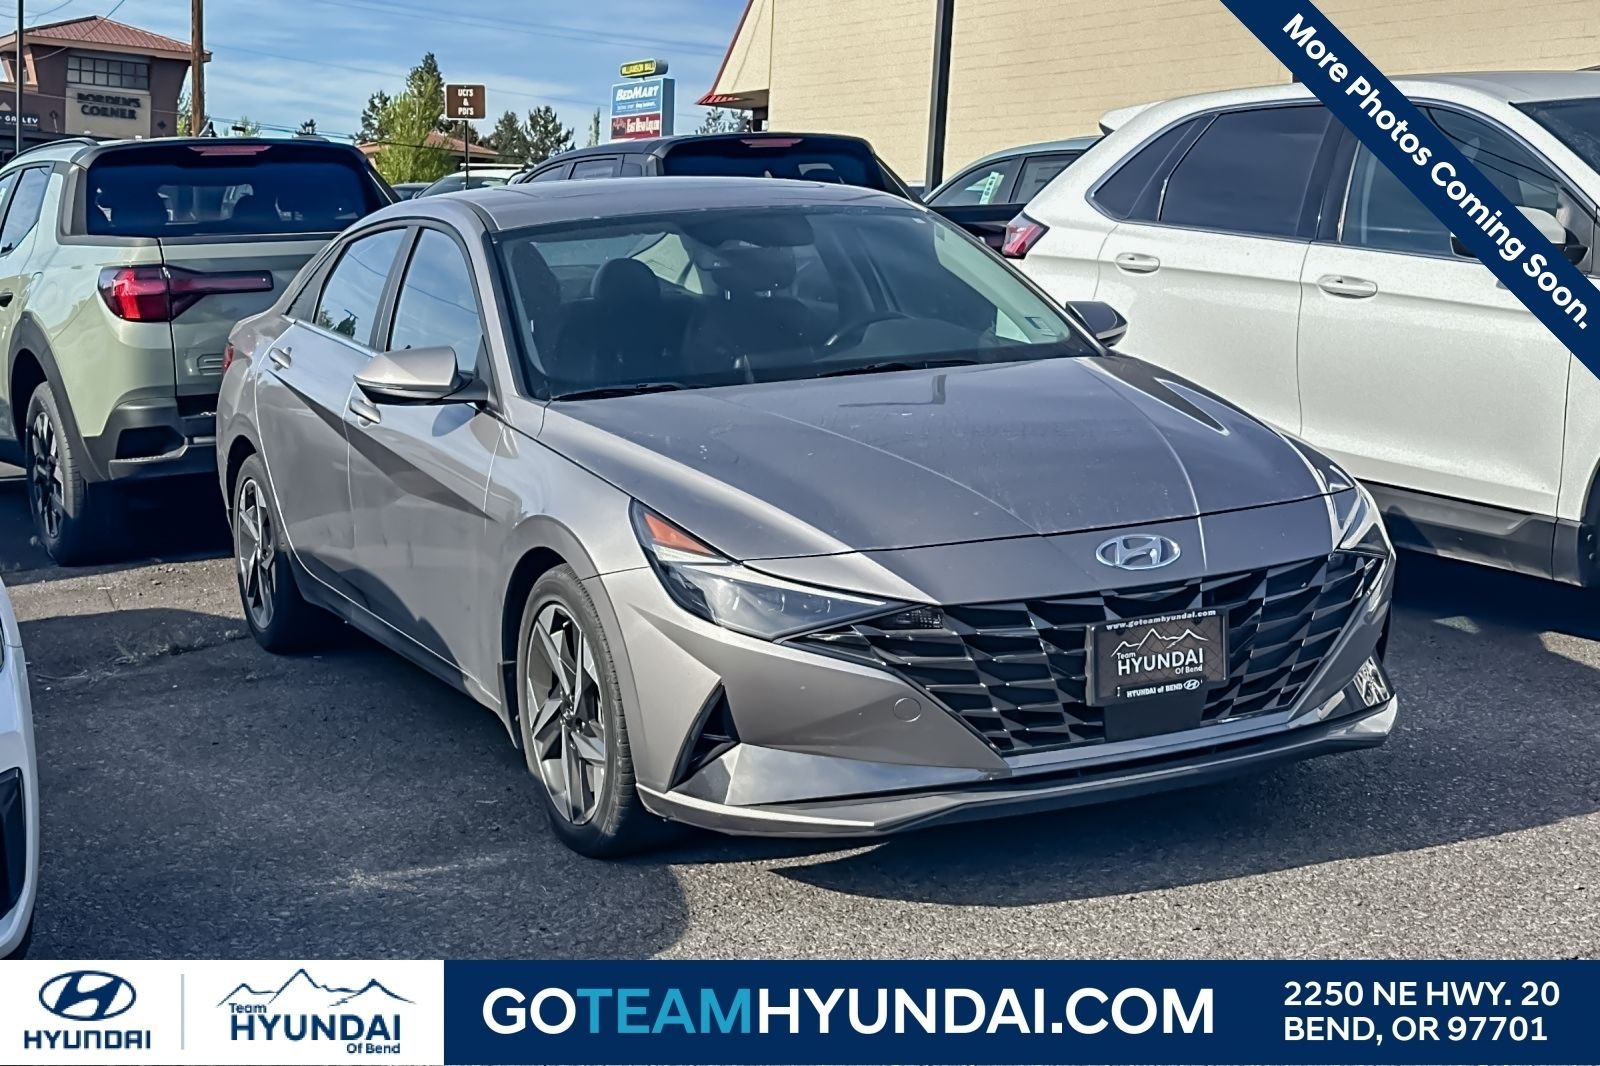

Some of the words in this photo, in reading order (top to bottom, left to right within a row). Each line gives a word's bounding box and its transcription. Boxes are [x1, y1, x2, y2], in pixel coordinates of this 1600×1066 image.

[1105, 609, 1217, 631] www.goteamhyundai.com
[1117, 651, 1136, 660] Team
[1117, 647, 1204, 676] HYUNDAI
[1185, 664, 1203, 674] Bend
[1126, 686, 1157, 698] HYUNDAI
[1157, 685, 1164, 694] of
[1165, 682, 1183, 692] BEND
